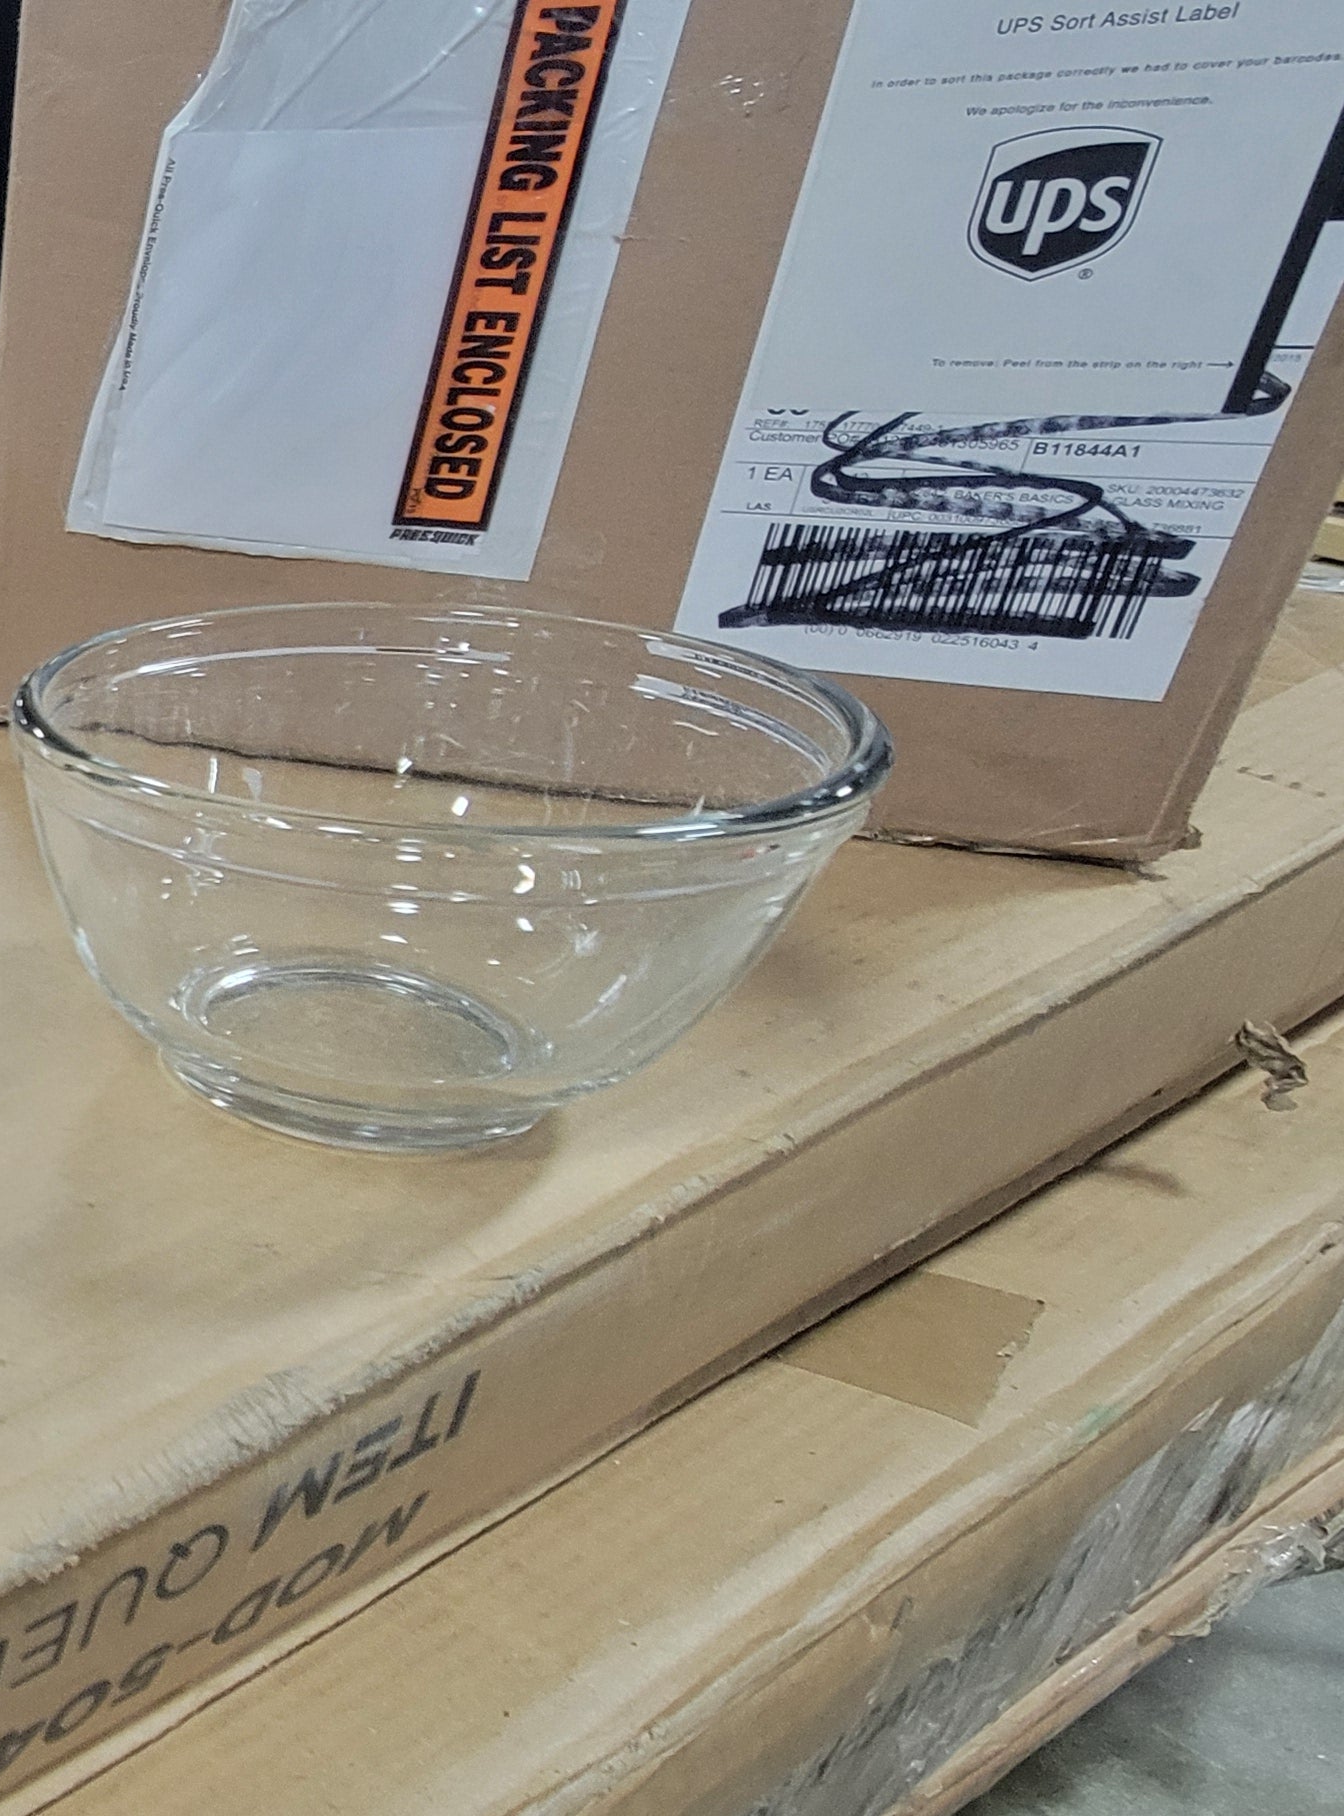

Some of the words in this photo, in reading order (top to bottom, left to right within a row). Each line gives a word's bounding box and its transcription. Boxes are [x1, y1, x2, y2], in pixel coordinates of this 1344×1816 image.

[996, 15, 1043, 35] UPS
[1050, 13, 1096, 31] Sort
[1099, 8, 1168, 28] Assist
[1174, 2, 1241, 23] Label
[887, 78, 921, 88] order
[924, 76, 937, 86] to
[941, 75, 966, 85] sort
[970, 71, 994, 83] this
[997, 70, 1053, 83] package
[1056, 65, 1116, 79] correctly
[1120, 65, 1140, 74] we
[1144, 62, 1170, 73] had
[1173, 62, 1188, 72] to
[1192, 60, 1233, 71] cover
[1236, 57, 1270, 69] your
[497, 5, 602, 191] PACKING
[965, 107, 988, 117] We
[990, 102, 1056, 117] apologize
[1059, 102, 1078, 112] for
[1082, 100, 1104, 111] the
[985, 176, 1132, 256] ups
[474, 211, 548, 295] LIST
[123, 331, 138, 361] Made
[931, 358, 948, 367] To
[1002, 358, 1032, 367] Peel
[1035, 358, 1064, 369] from
[1067, 359, 1089, 368] the
[1092, 360, 1122, 371] strip
[1125, 361, 1143, 369] on
[1145, 360, 1168, 369] the
[1171, 360, 1203, 371] right
[423, 311, 521, 500] ENCLOSED
[749, 430, 822, 444] Customer
[1032, 442, 1142, 458] B11844A1
[747, 466, 757, 480] 1
[764, 466, 794, 482] EA
[746, 502, 773, 511] LAS
[1019, 492, 1075, 505] BASICS
[1166, 499, 1225, 511] MIXING
[1027, 641, 1039, 651] 4
[249, 1368, 483, 1555] ITEM
